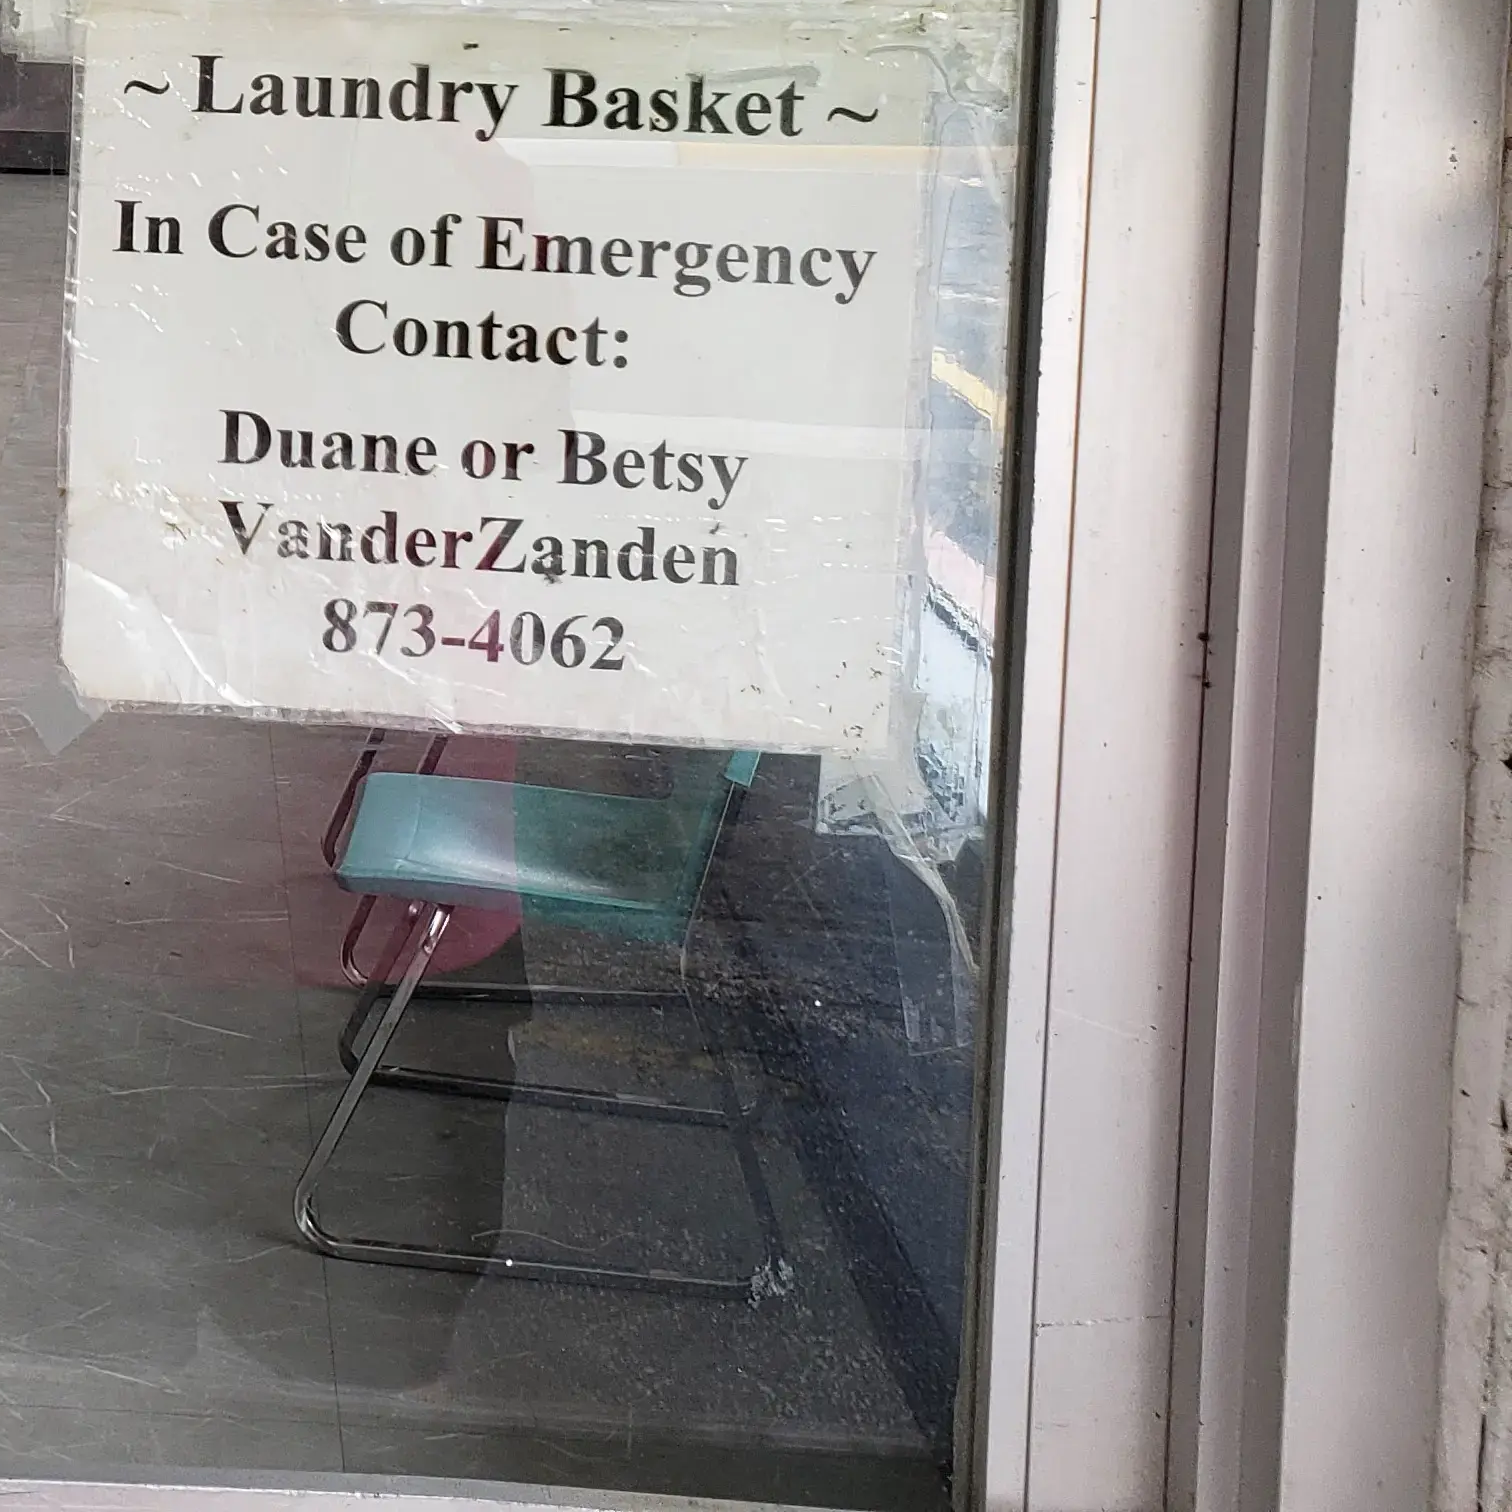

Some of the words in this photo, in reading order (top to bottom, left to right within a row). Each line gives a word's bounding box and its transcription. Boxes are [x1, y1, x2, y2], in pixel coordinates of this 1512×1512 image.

[192, 55, 519, 142] Laundry
[542, 68, 804, 136] Basket
[113, 200, 183, 254] In
[209, 204, 366, 263] Case
[391, 214, 462, 267] of
[476, 216, 877, 304] Emergency
[336, 300, 628, 368] Contact:
[220, 410, 436, 475] Duane
[462, 440, 534, 480] or
[558, 429, 748, 510] Betsy
[219, 499, 740, 587] VanderZanden
[323, 599, 624, 670] 873-4062
